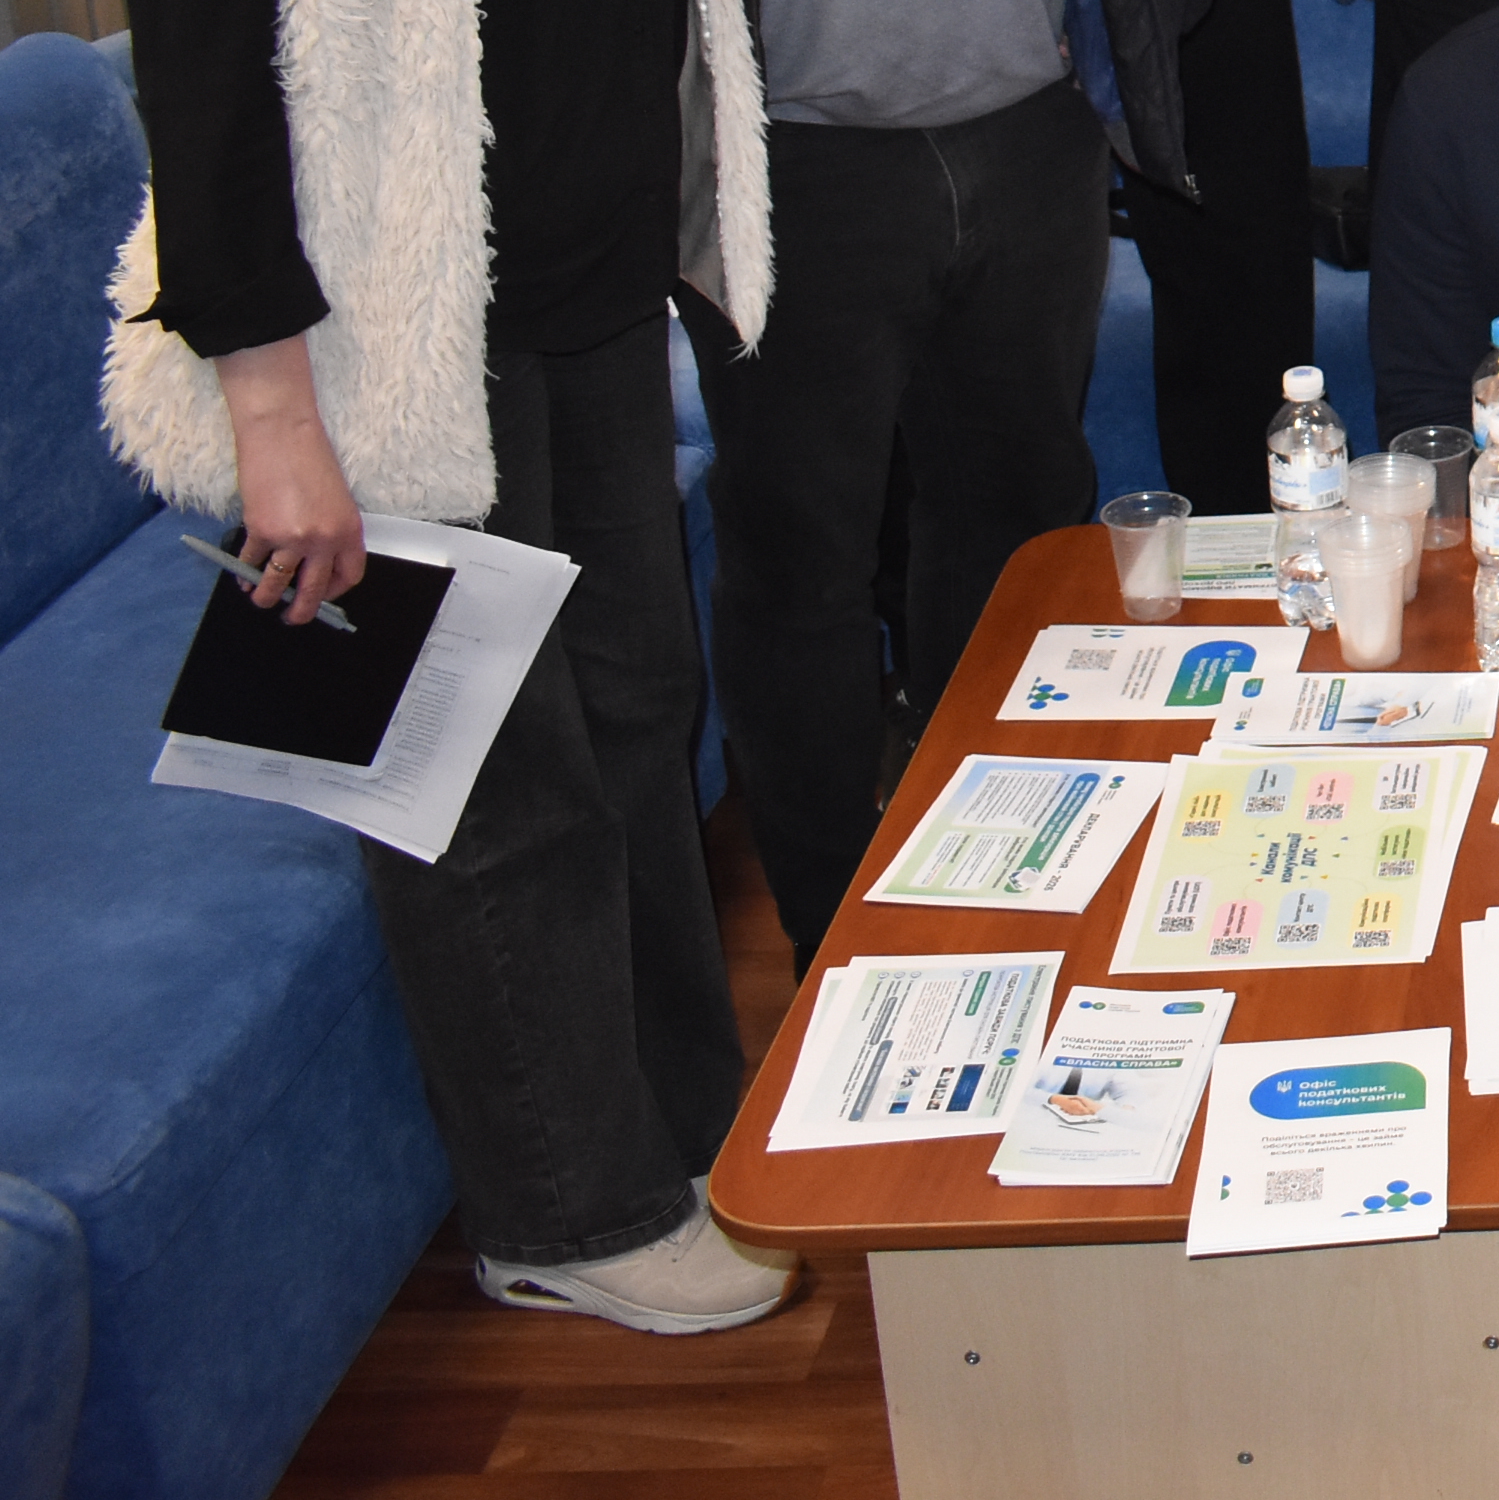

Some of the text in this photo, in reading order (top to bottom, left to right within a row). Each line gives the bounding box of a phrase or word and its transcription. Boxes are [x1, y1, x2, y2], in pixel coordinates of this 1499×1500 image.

[1260, 841, 1283, 875] Канали
[1272, 832, 1307, 883] комунікації
[1298, 846, 1321, 867] ДПС
[1061, 1036, 1194, 1047] ПОДАТКОВА ПІДТРИМКА
[1062, 1044, 1186, 1053] УЧАСНИКІВ ГРАНТОВОЇ
[1059, 1058, 1178, 1068] «ВЛАСНА СПРАВА»
[1297, 1084, 1386, 1099] податкових
[1298, 1078, 1337, 1091] Офіс
[1297, 1091, 1406, 1108] консультантів
